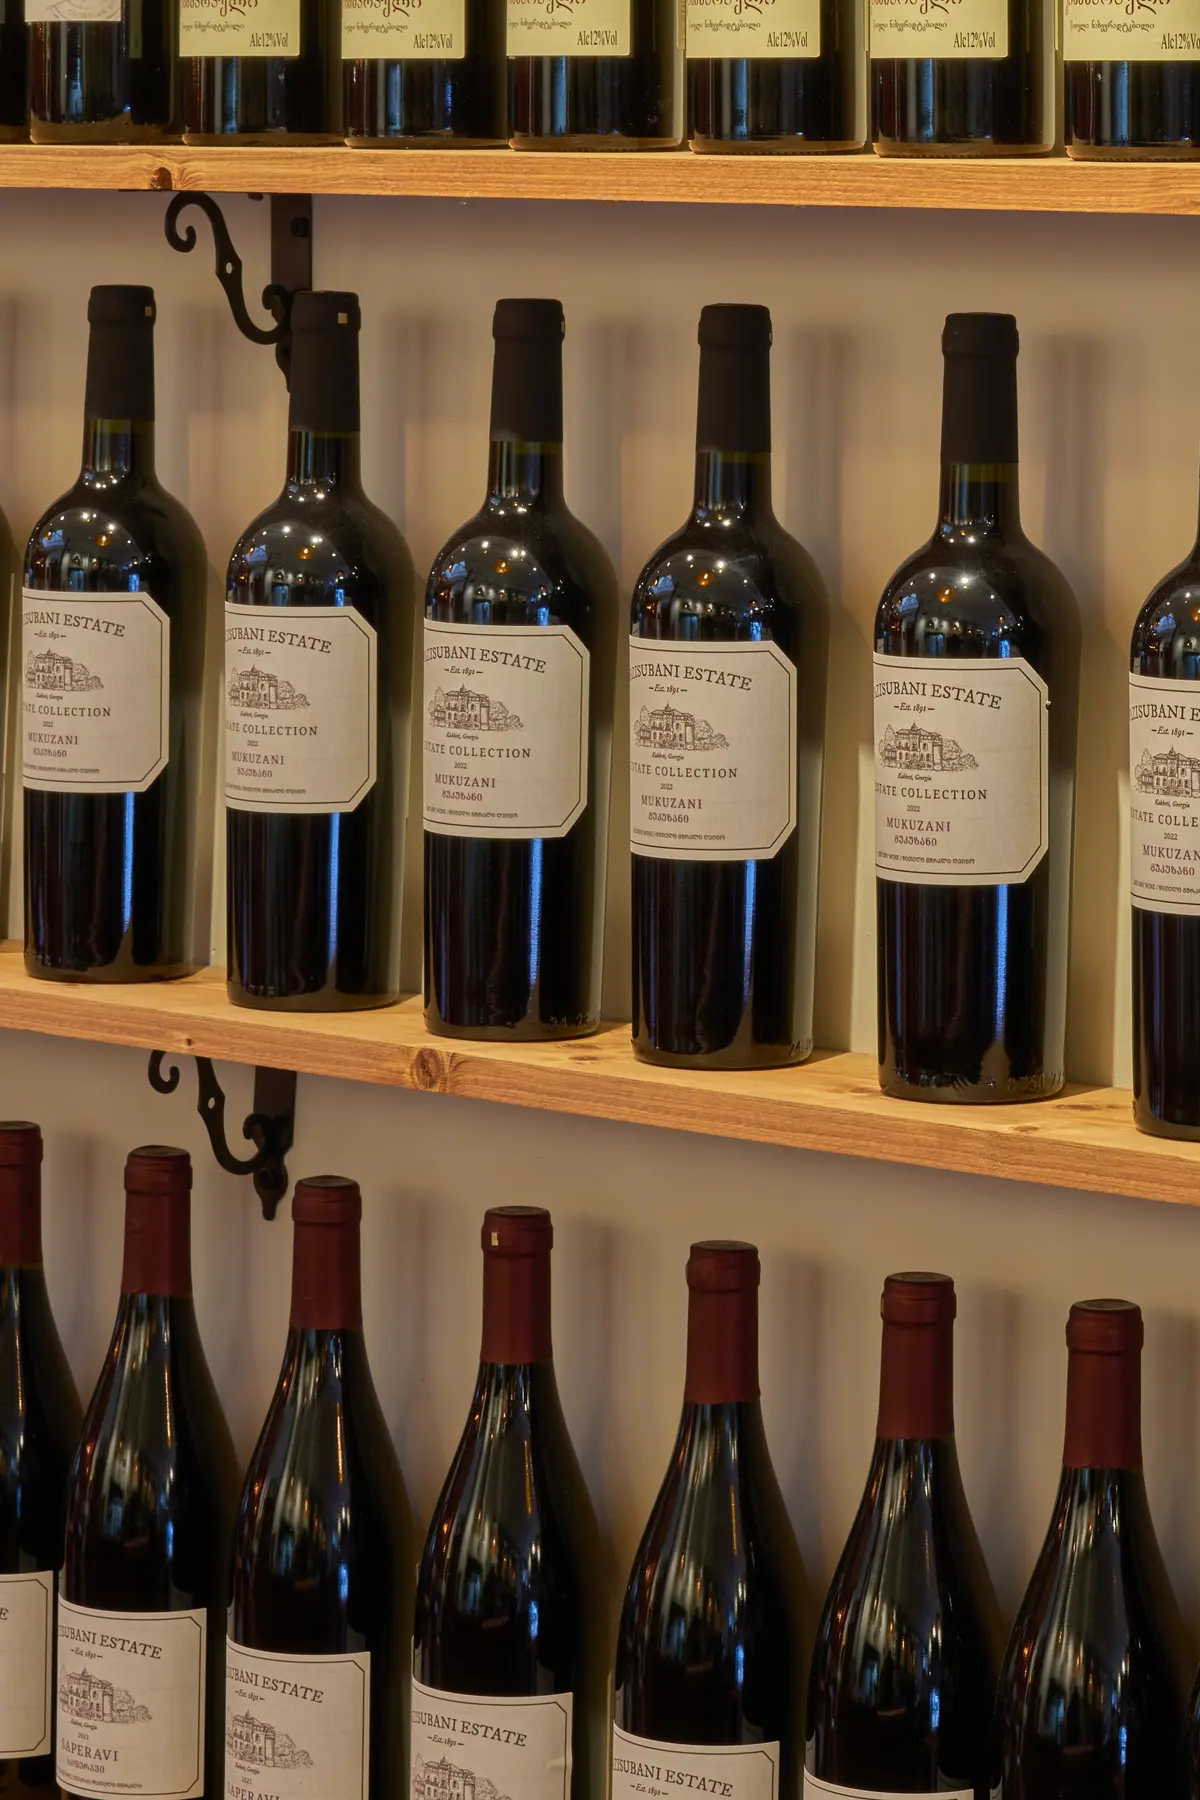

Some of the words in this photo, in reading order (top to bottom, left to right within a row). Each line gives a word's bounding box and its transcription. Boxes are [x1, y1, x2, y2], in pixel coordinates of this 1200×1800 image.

[63, 612, 126, 638] ESTATE
[268, 629, 332, 654] ESTATE
[479, 648, 546, 674] ESTATE
[683, 665, 753, 691] ESTATE
[930, 684, 1002, 710] ESTATE
[38, 704, 111, 717] COLLECTION
[27, 731, 79, 746] MUKUZANI
[231, 750, 285, 765] MUKUZANI
[449, 745, 531, 758] COLLECTION
[434, 773, 497, 788] MUKUZANI
[655, 765, 738, 778] COLLECTION
[641, 794, 703, 810] MUKUZANI
[901, 787, 987, 800] COLLECTION
[886, 816, 951, 832] MUKUZANI
[99, 1633, 163, 1660] ESTATE
[261, 1676, 325, 1704] ESTATE
[460, 1718, 528, 1748] ESTATE
[60, 1739, 119, 1763] SAPERAVI
